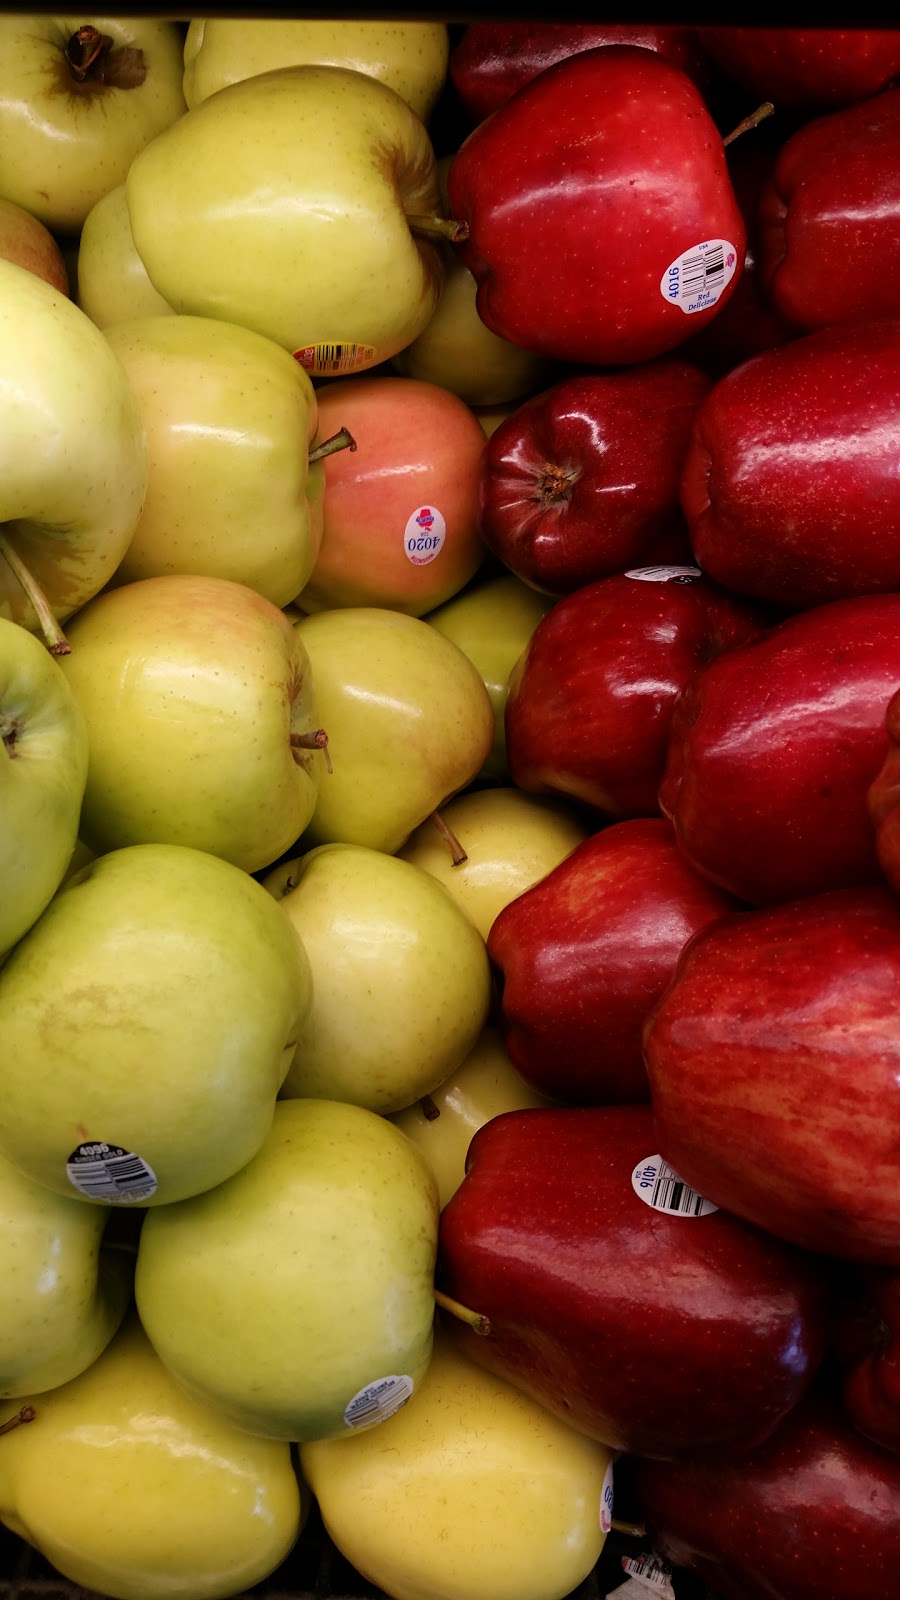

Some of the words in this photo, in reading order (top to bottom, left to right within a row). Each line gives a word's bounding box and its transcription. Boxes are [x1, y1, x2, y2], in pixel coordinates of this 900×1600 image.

[668, 267, 680, 298] 4016
[688, 296, 717, 312] Delicious
[697, 291, 710, 301] Red
[408, 536, 441, 552] 4020
[80, 1143, 110, 1156] 4096
[102, 1149, 123, 1159] GOLD
[640, 1165, 657, 1188] 4016
